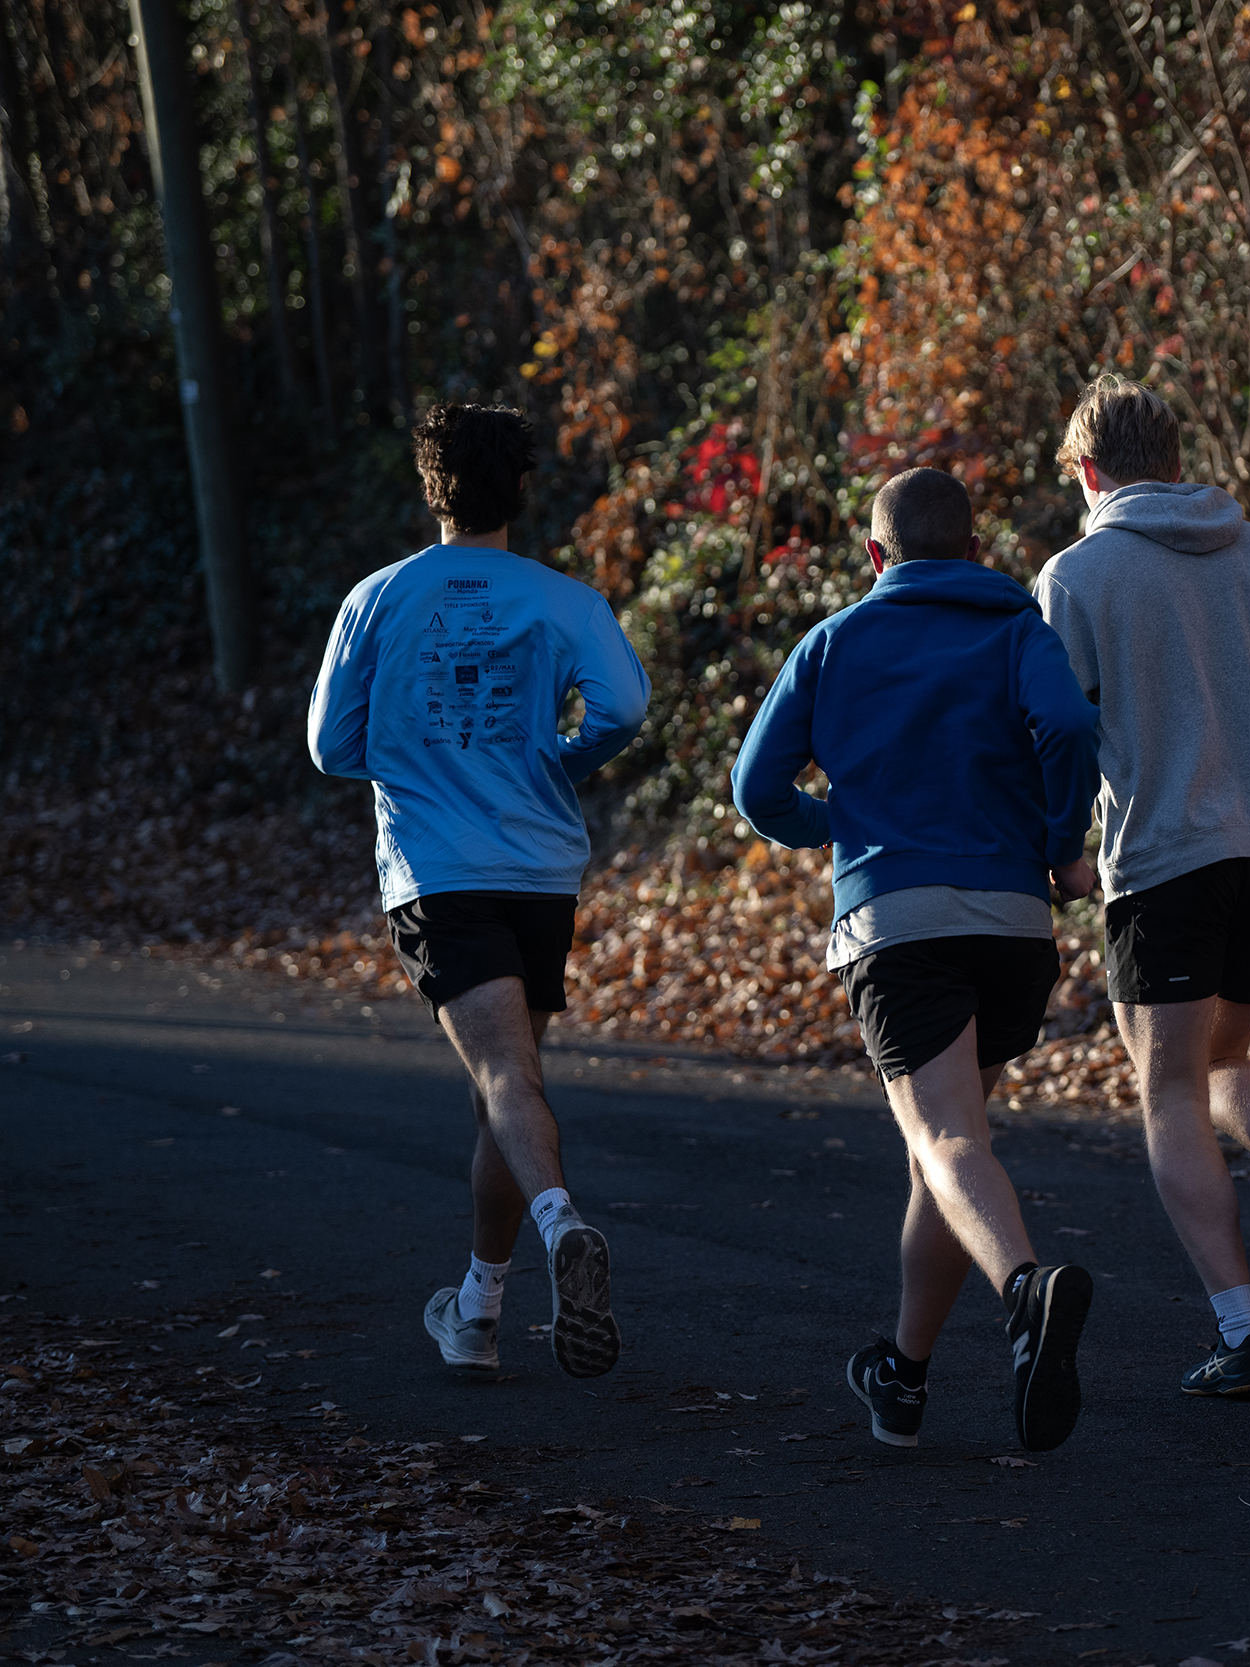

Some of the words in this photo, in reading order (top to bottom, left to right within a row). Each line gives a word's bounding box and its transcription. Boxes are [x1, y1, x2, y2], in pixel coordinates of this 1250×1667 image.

[448, 579, 488, 589] POHANKA
[492, 686, 512, 695] DICK'S
[485, 700, 516, 711] Wegmans
[897, 1396, 921, 1405] balance
